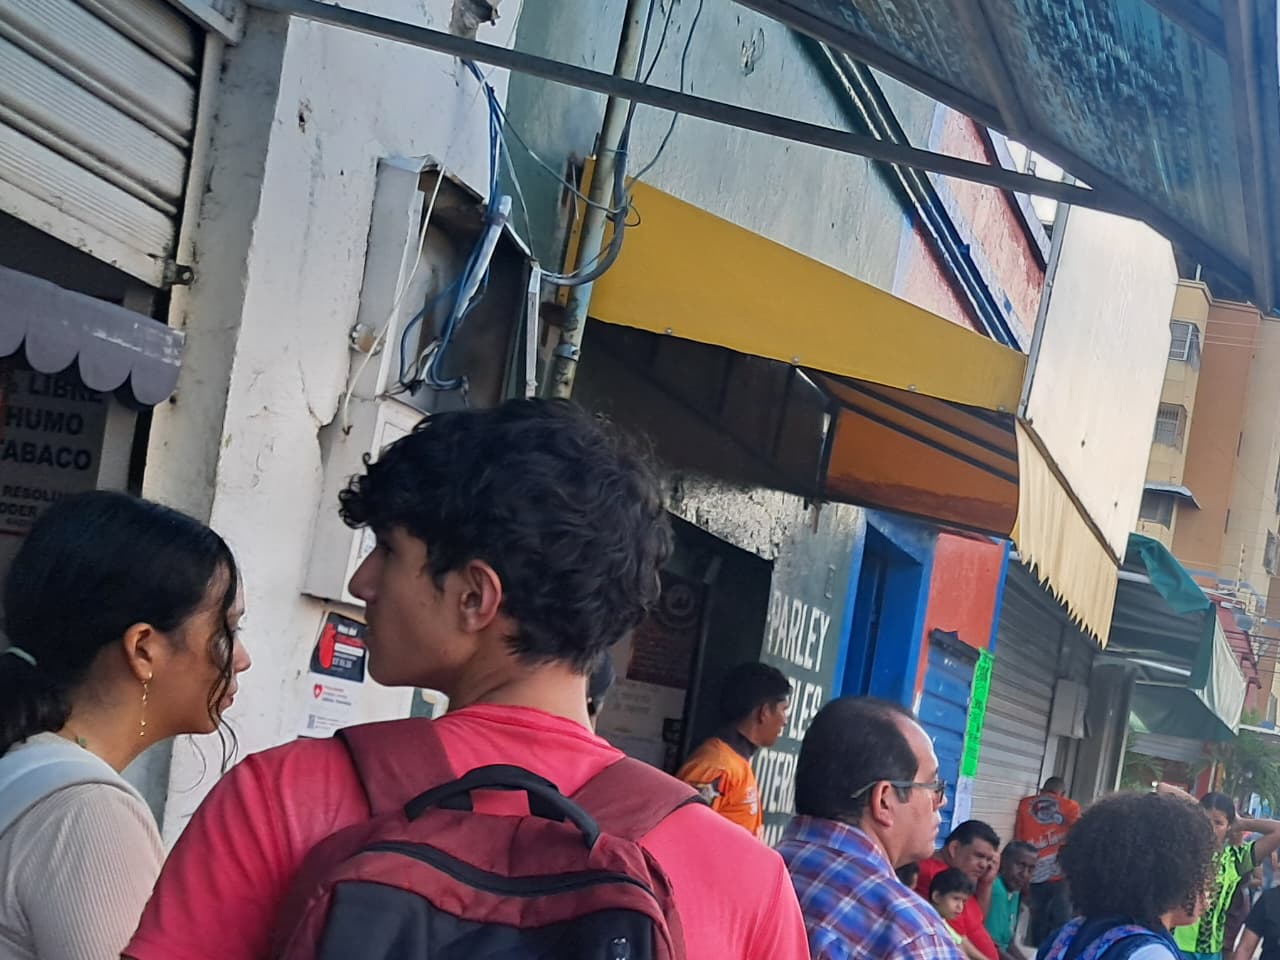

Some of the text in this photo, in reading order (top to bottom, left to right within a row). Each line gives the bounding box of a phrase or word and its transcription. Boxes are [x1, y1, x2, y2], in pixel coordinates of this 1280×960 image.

[6, 405, 84, 436] HUMO
[0, 437, 93, 471] ABACO
[768, 590, 830, 673] PARLEY
[749, 745, 799, 814] OTERI
